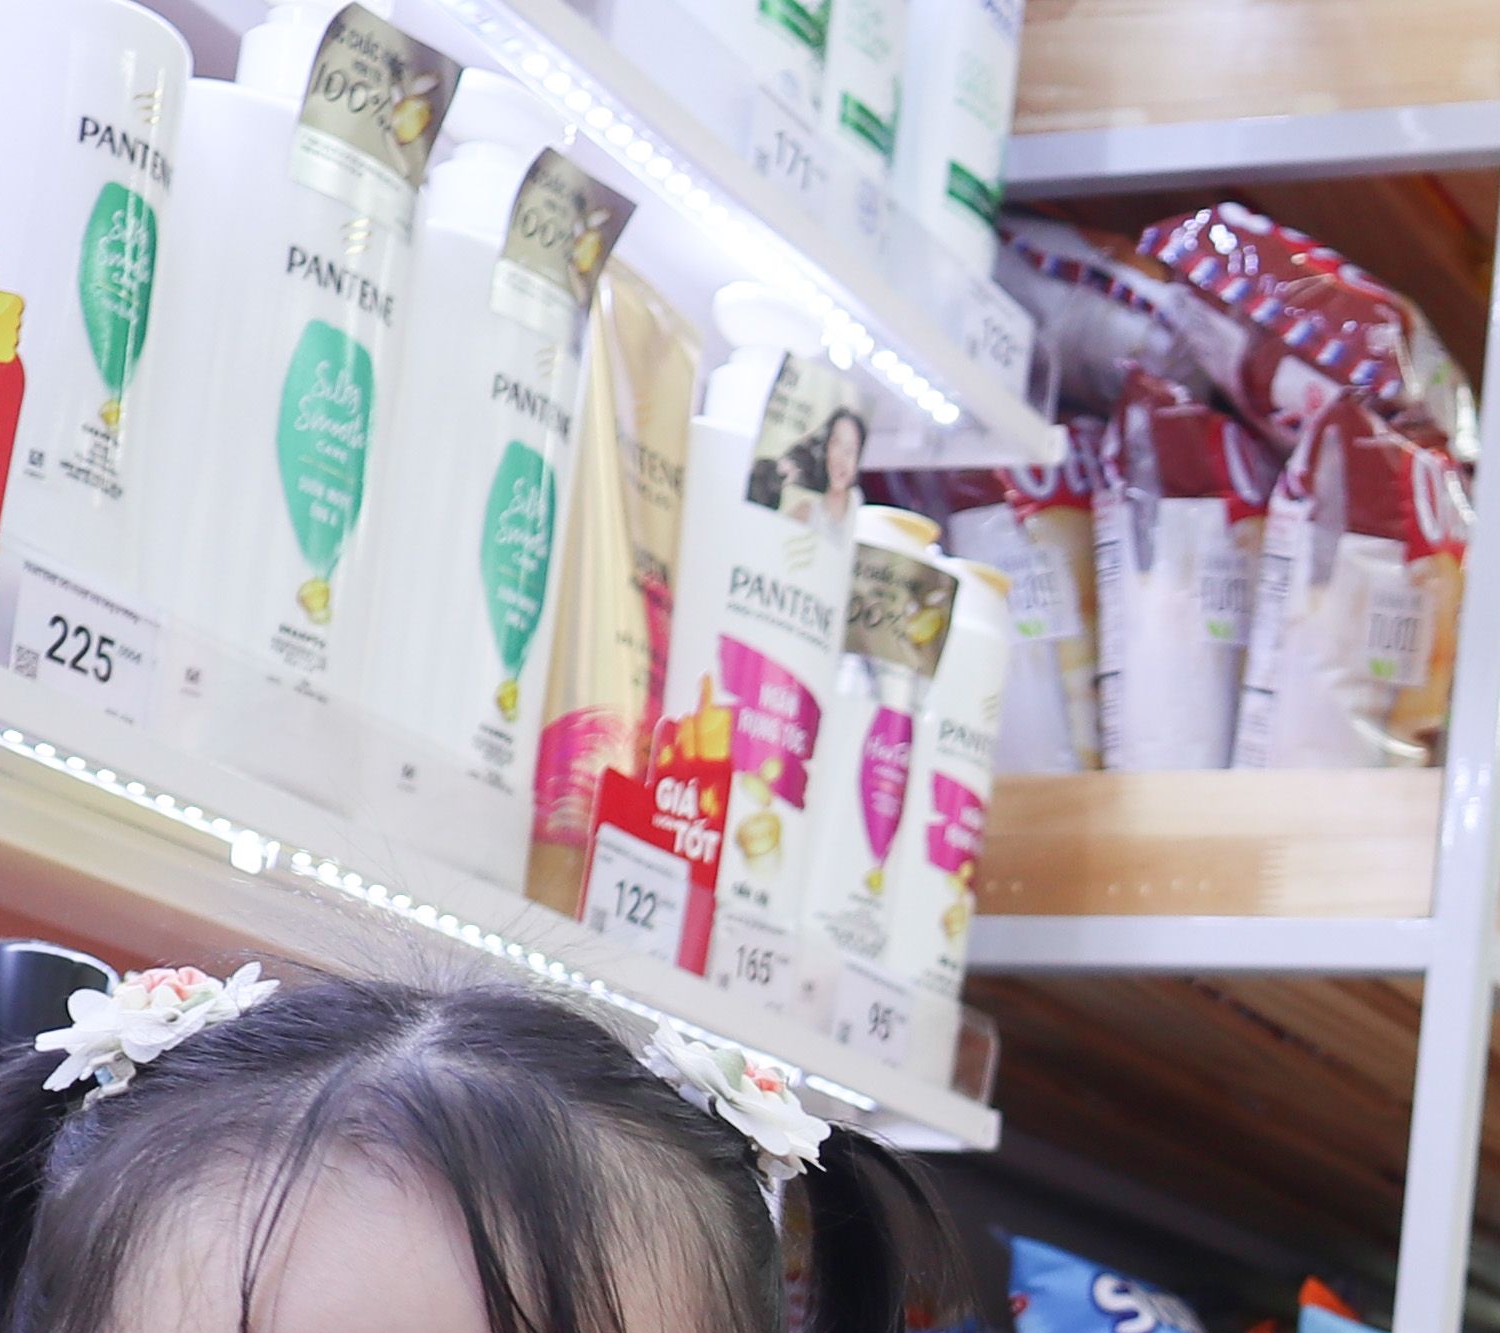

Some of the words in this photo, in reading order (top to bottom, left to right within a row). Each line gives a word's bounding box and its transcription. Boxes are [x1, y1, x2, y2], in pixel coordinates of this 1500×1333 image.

[286, 245, 396, 328] PANTENE
[729, 566, 839, 632] PANTENE
[45, 613, 118, 686] 225
[655, 776, 700, 821] GIÁ
[673, 818, 722, 864] TỐT
[613, 878, 658, 931] 122
[735, 942, 775, 988] 165
[866, 1000, 894, 1042] 95
